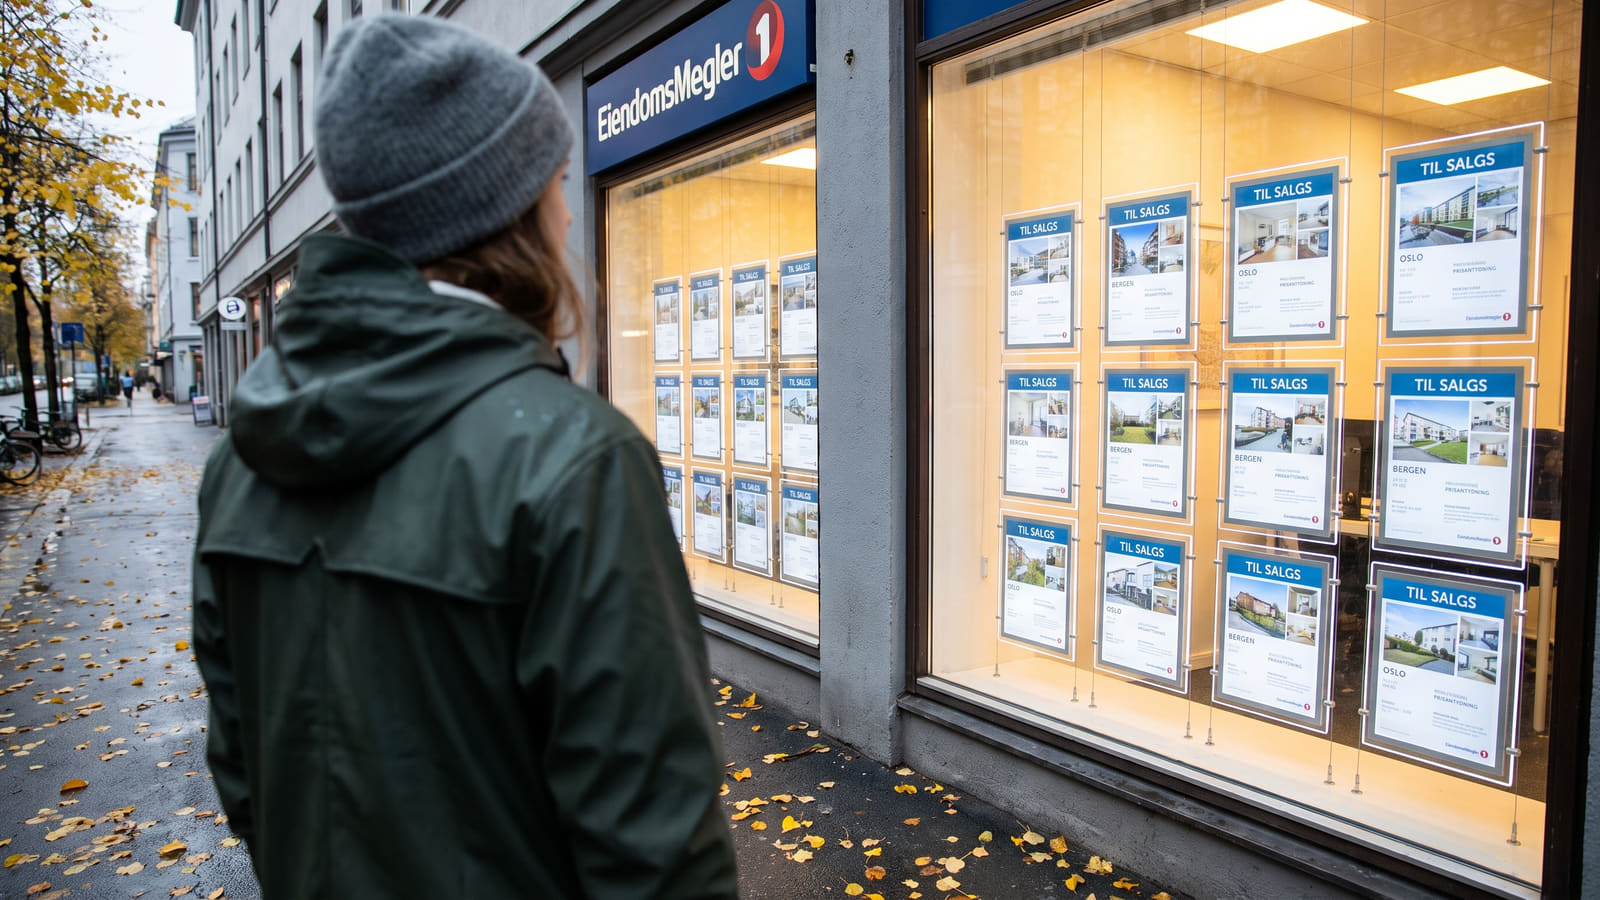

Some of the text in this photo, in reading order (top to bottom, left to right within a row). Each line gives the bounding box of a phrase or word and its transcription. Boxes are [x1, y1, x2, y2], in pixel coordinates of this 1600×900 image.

[598, 13, 770, 142] EiendomsMegler 1
[1420, 152, 1495, 176] TIL SALGS
[1254, 181, 1312, 201] TIL SALGS
[1124, 204, 1170, 220] TIL SALGS
[1020, 221, 1058, 236] TIL SALGS
[1399, 254, 1424, 263] OSLO
[1238, 269, 1258, 277] OSLO
[1112, 280, 1134, 288] BERGEN
[1019, 377, 1057, 388] TIL SALGS
[1122, 378, 1169, 389] TIL SALGS
[1251, 378, 1308, 390] TIL SALGS
[1414, 378, 1488, 392] TIL SALGS
[1110, 446, 1133, 454] BERGEN
[1235, 454, 1262, 463] BERGEN
[1392, 465, 1427, 475] BERGEN
[1018, 525, 1055, 540] TIL SALGS
[1120, 541, 1165, 558] TIL SALGS
[1245, 561, 1301, 580] TIL SALGS
[1406, 586, 1477, 609] TIL SALGS
[1228, 633, 1255, 645] BERGEN
[1383, 666, 1406, 678] OSLO
